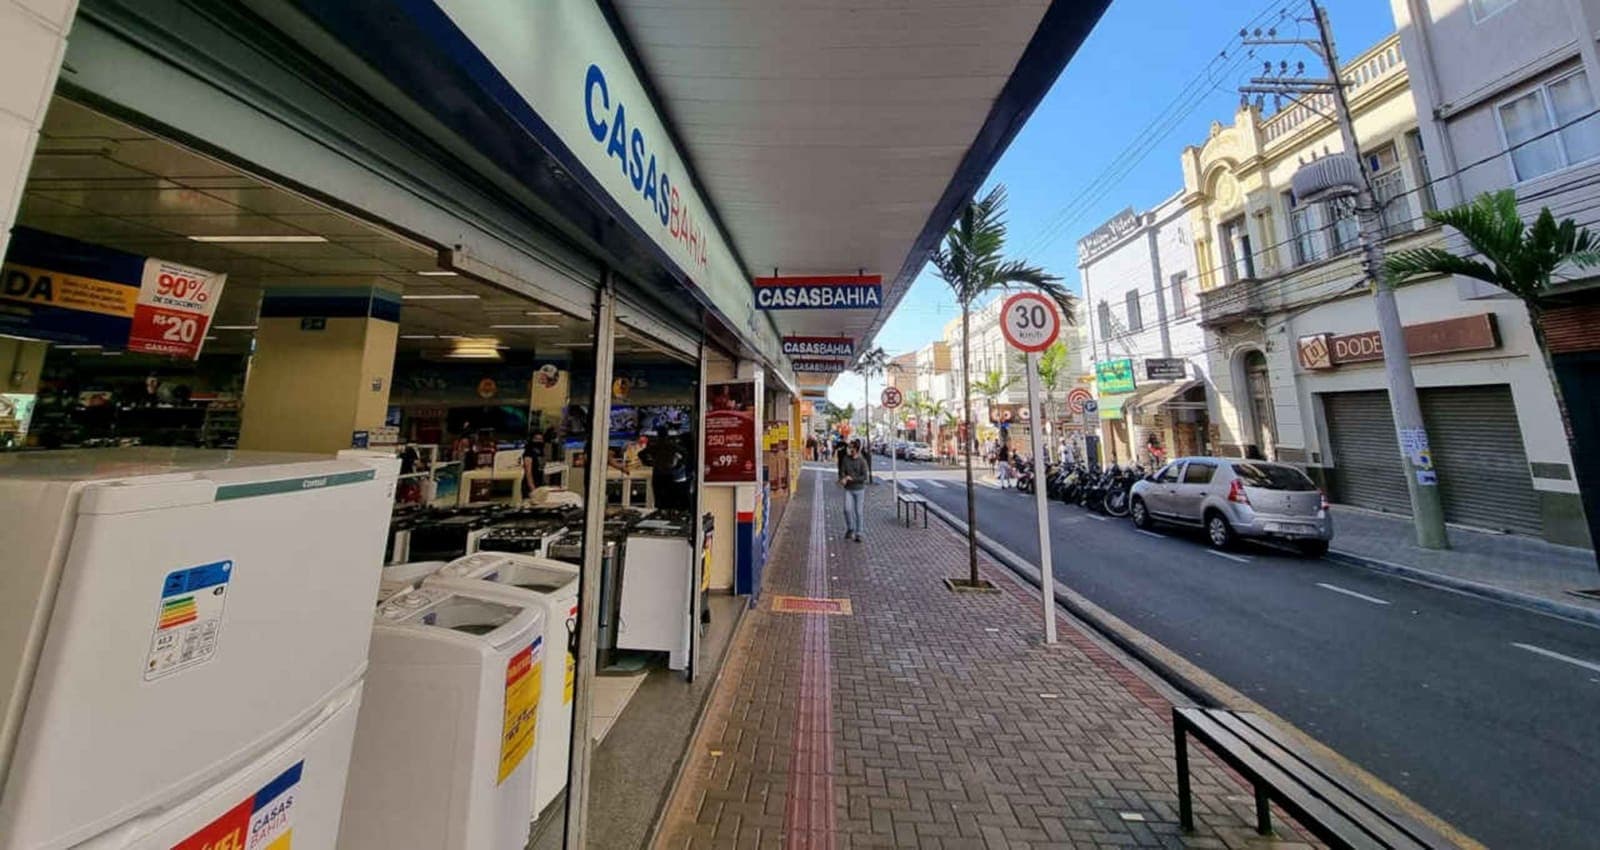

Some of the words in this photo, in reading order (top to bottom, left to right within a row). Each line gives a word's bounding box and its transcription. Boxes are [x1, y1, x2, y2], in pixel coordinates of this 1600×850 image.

[157, 273, 207, 302] 90%
[758, 286, 879, 306] CASASBAHIA
[1016, 305, 1046, 329] 30
[163, 317, 197, 343] 20
[784, 341, 852, 354] CASASBAHIA
[253, 796, 293, 834] CASAS
